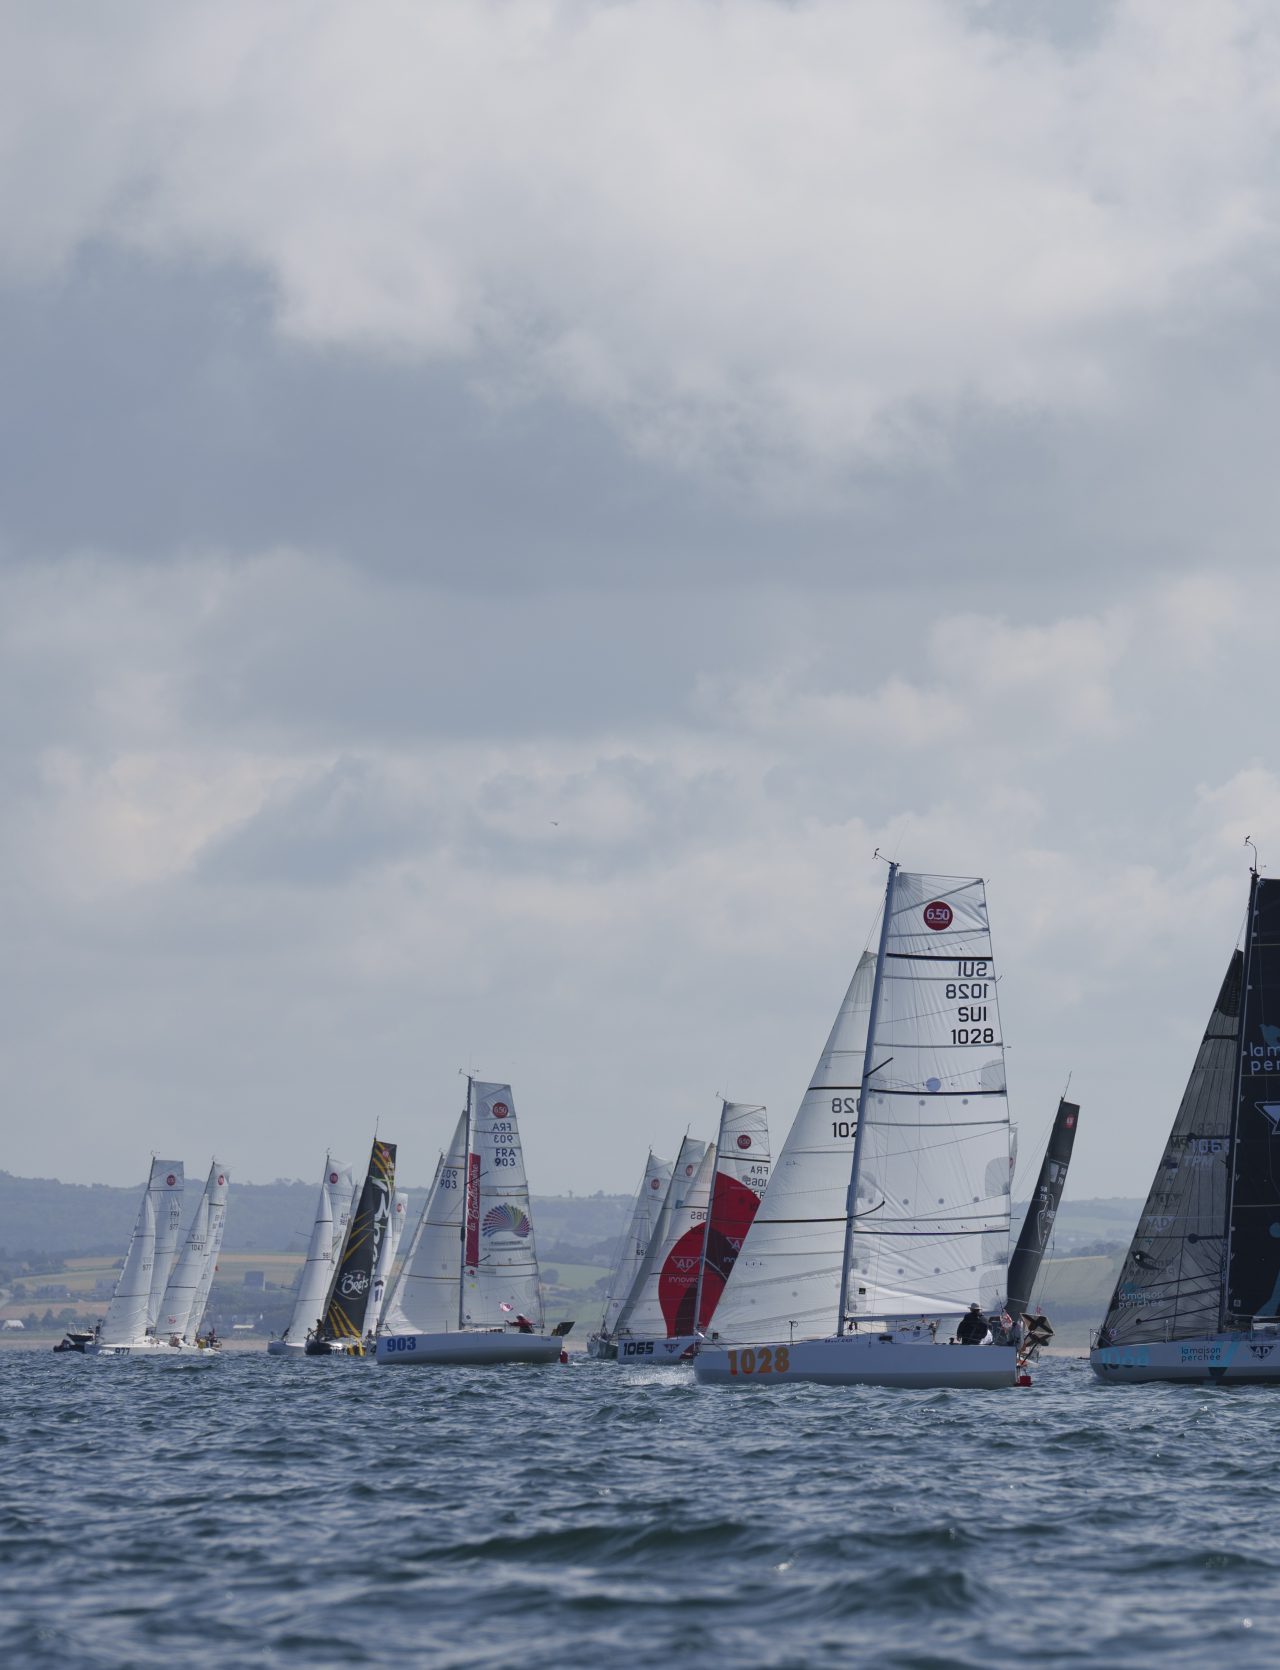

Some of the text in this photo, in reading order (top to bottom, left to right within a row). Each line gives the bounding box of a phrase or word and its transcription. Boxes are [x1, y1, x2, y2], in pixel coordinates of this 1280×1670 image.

[958, 1006, 987, 1022] SUI
[951, 1029, 994, 1045] 1028
[832, 1122, 858, 1138] 102
[495, 1148, 517, 1157] FRA
[494, 1157, 516, 1167] 903
[387, 1337, 417, 1352] 903
[624, 1342, 655, 1355] 1065
[728, 1346, 790, 1376] 1028
